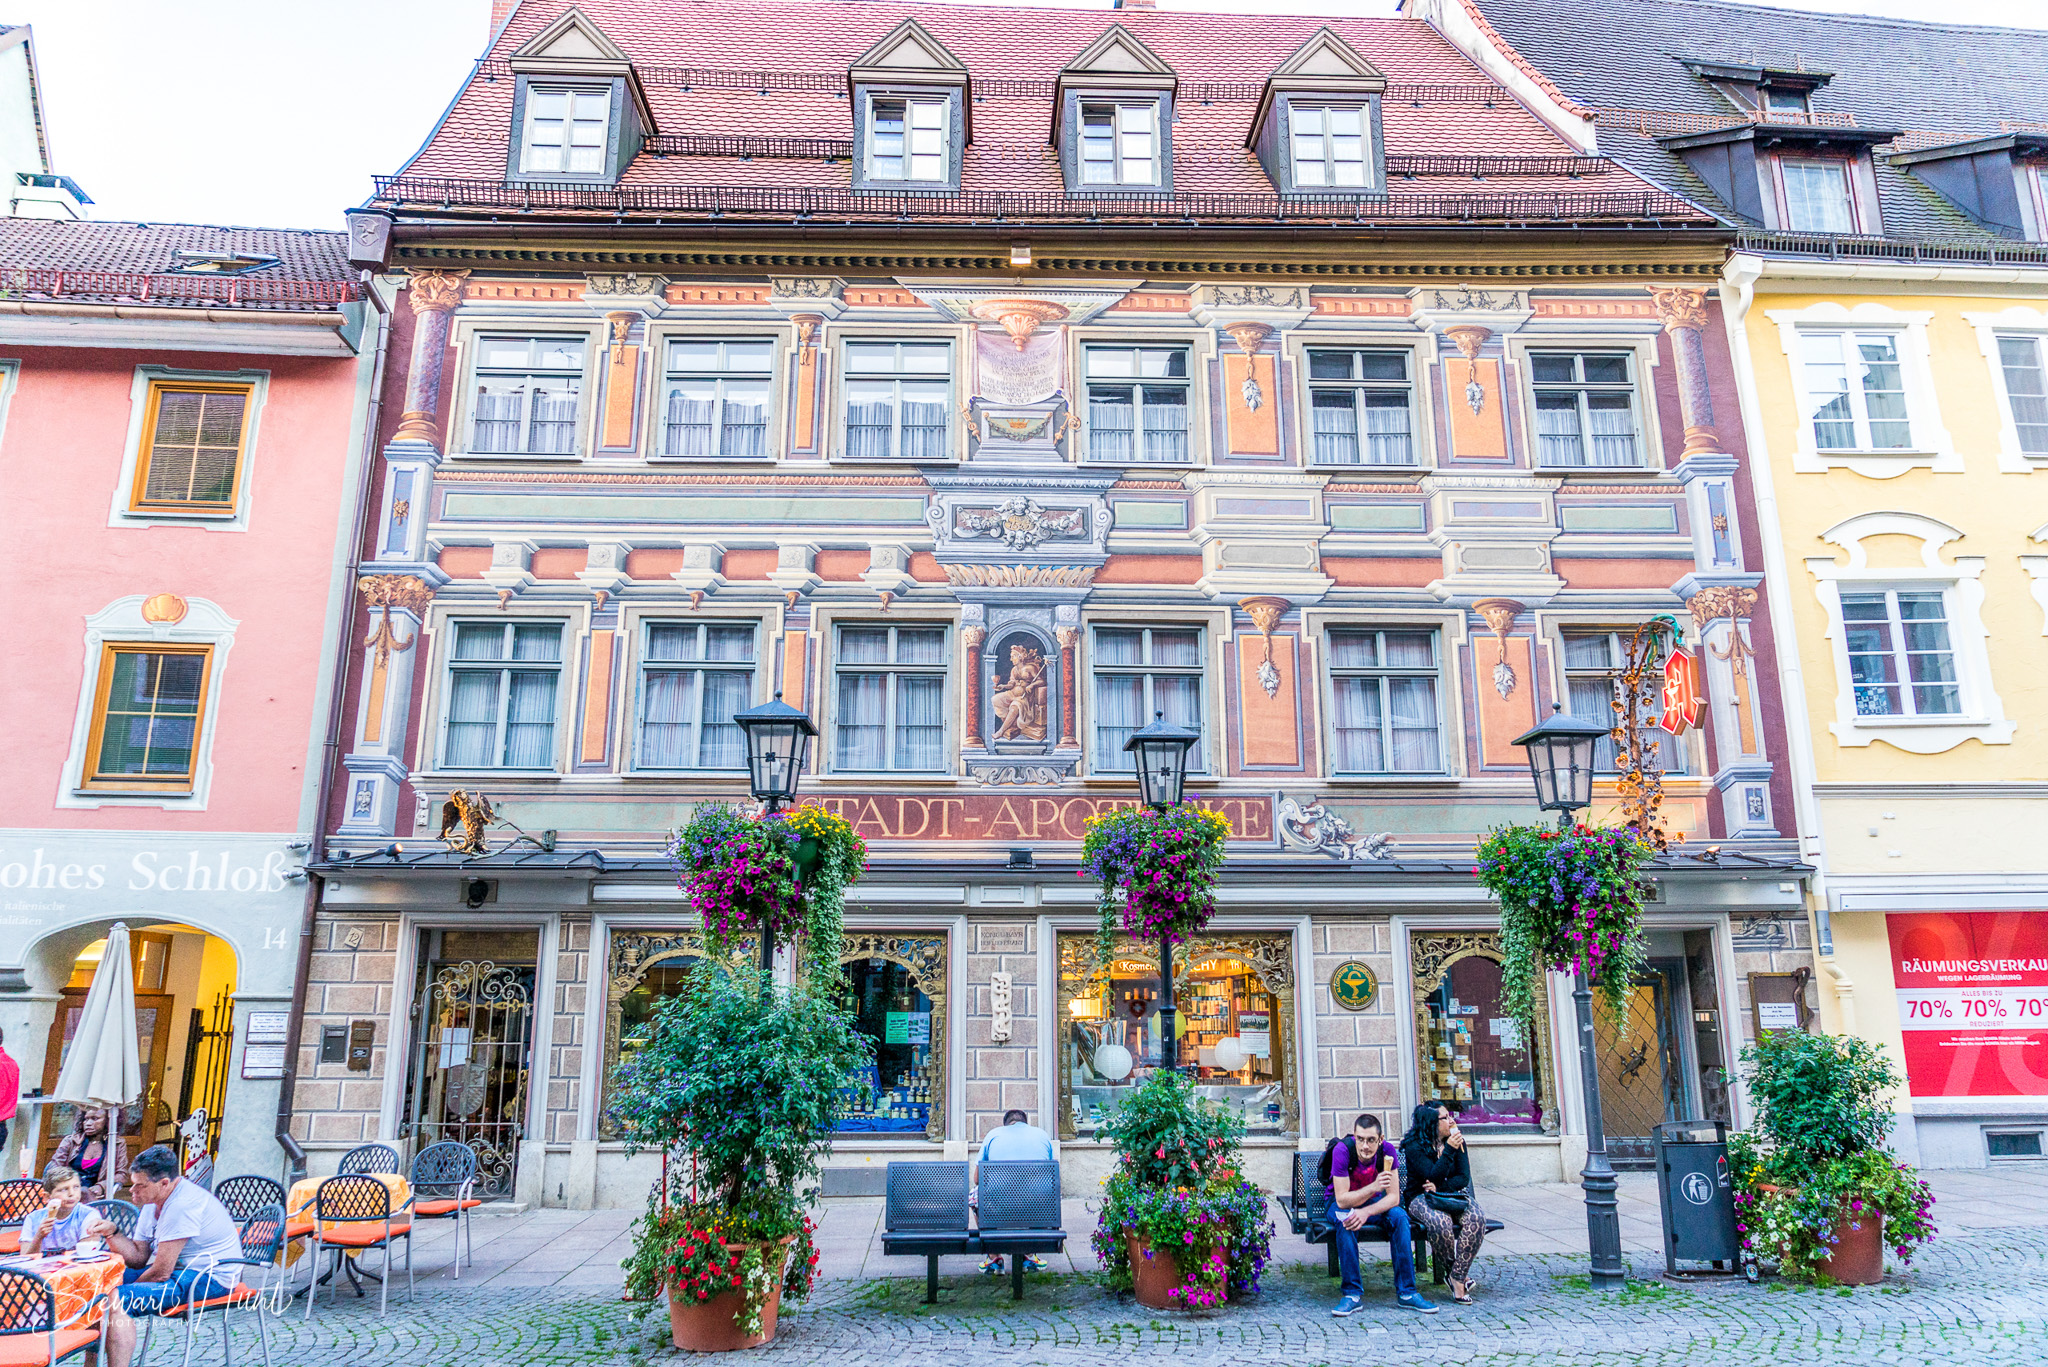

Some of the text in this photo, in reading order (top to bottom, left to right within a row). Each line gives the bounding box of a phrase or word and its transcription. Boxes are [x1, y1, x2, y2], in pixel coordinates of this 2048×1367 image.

[0, 847, 287, 892] ohes Schloß
[263, 926, 287, 949] 14
[349, 932, 360, 945] 12
[1964, 973, 2022, 981] LAGERRÄUMUNG
[1907, 1000, 1952, 1018] 70%
[1961, 999, 2007, 1017] 70%
